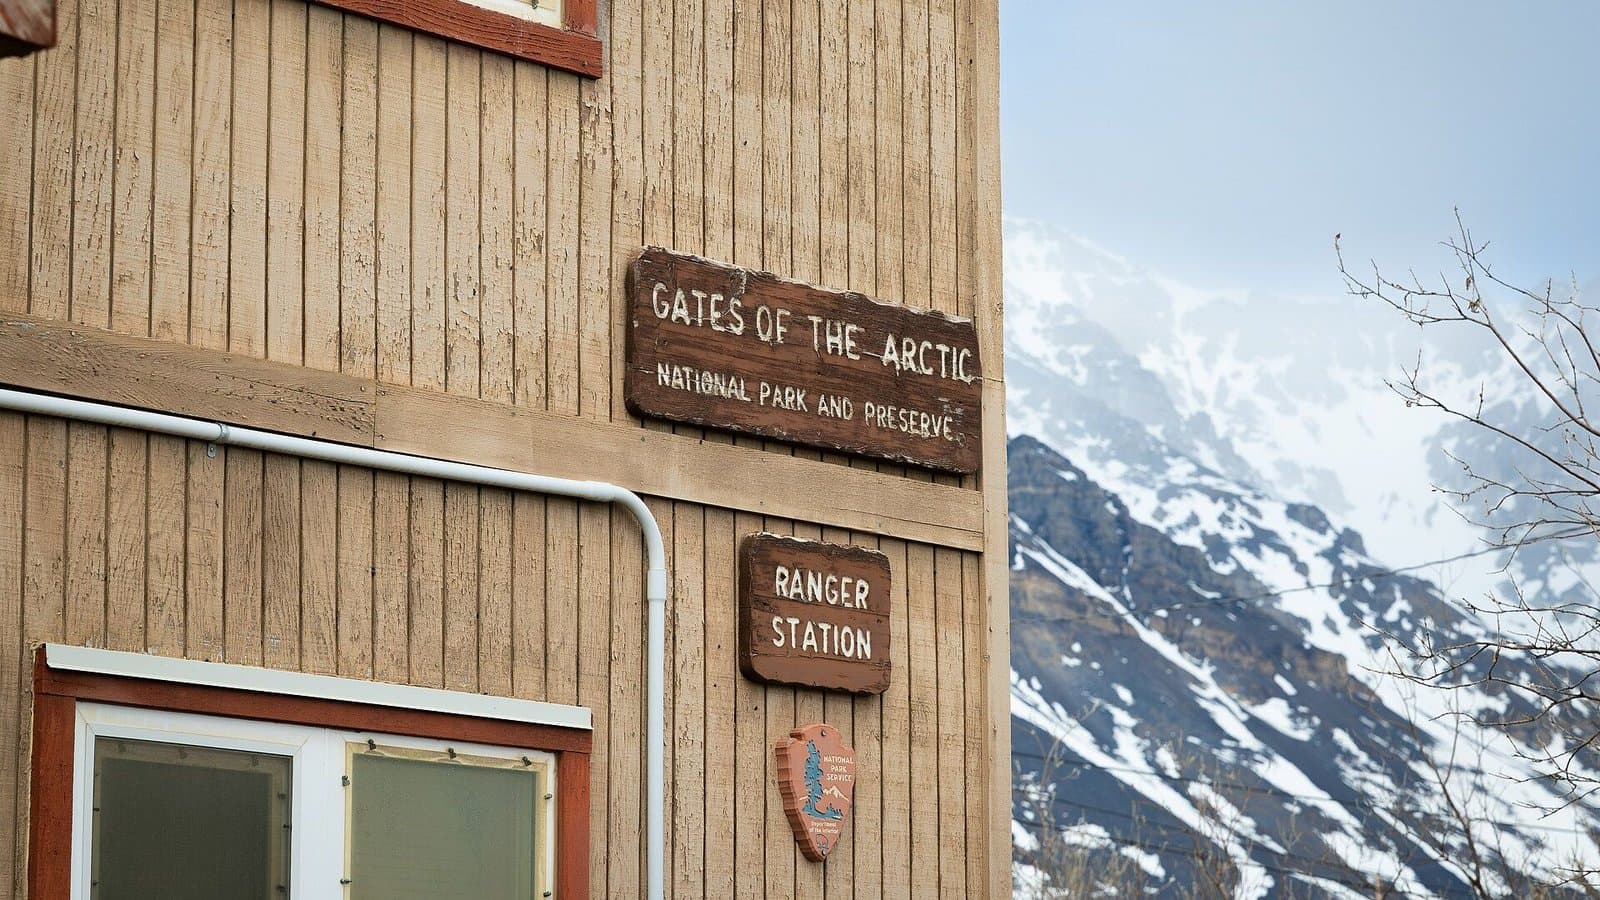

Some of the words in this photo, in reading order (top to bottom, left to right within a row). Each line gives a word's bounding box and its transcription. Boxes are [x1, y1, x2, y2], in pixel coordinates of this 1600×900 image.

[652, 282, 745, 336] GATES
[756, 305, 791, 344] OF
[808, 315, 864, 361] THE
[882, 334, 973, 383] ARCTIC
[657, 362, 751, 402] NATIONAL
[760, 381, 808, 412] PARK
[818, 394, 853, 421] AND
[865, 401, 955, 441] PRESERVE
[775, 565, 869, 609] RANGER
[772, 615, 871, 659] STATION
[823, 755, 854, 764] NATIONAL
[826, 773, 852, 782] SERVICE
[830, 765, 847, 773] PARK
